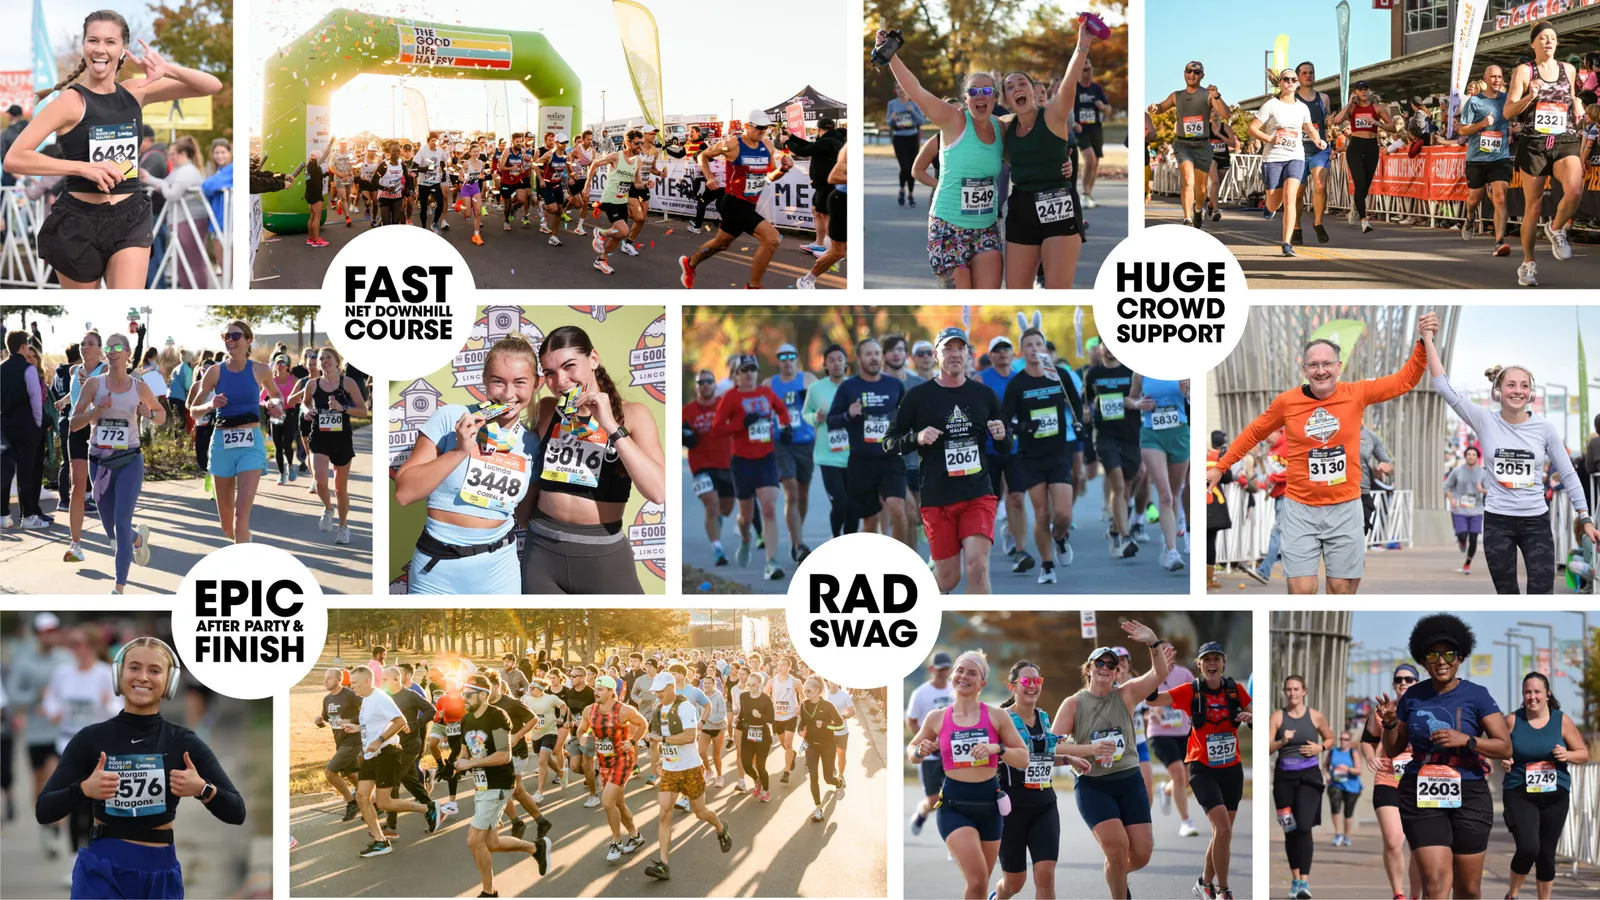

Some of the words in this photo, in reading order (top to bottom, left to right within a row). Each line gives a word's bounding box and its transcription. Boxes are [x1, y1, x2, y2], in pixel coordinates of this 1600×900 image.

[415, 28, 434, 37] THE
[416, 37, 450, 47] GOOD
[417, 46, 436, 56] LIFE
[1537, 114, 1564, 126] 2321
[1186, 124, 1201, 132] 576
[1481, 139, 1501, 147] 5148
[964, 190, 994, 203] 1549
[1038, 200, 1072, 217] 2472
[320, 416, 342, 424] 2760
[1153, 415, 1178, 425] 5839
[102, 430, 124, 440] 772
[224, 432, 254, 444] 2574
[947, 450, 978, 465] 2067
[484, 463, 511, 475] Lucinda
[1311, 460, 1344, 474] 3130
[1496, 463, 1530, 476] 3051
[467, 468, 522, 497] 3448
[477, 490, 498, 501] CORRAL
[641, 526, 666, 538] GOOD
[954, 742, 986, 755] 39
[1209, 742, 1235, 756] 3257
[1027, 766, 1051, 777] 5528
[1528, 773, 1556, 784] 2749
[117, 778, 162, 798] 576
[1419, 782, 1460, 796] 2603
[114, 799, 153, 808] Dragons
